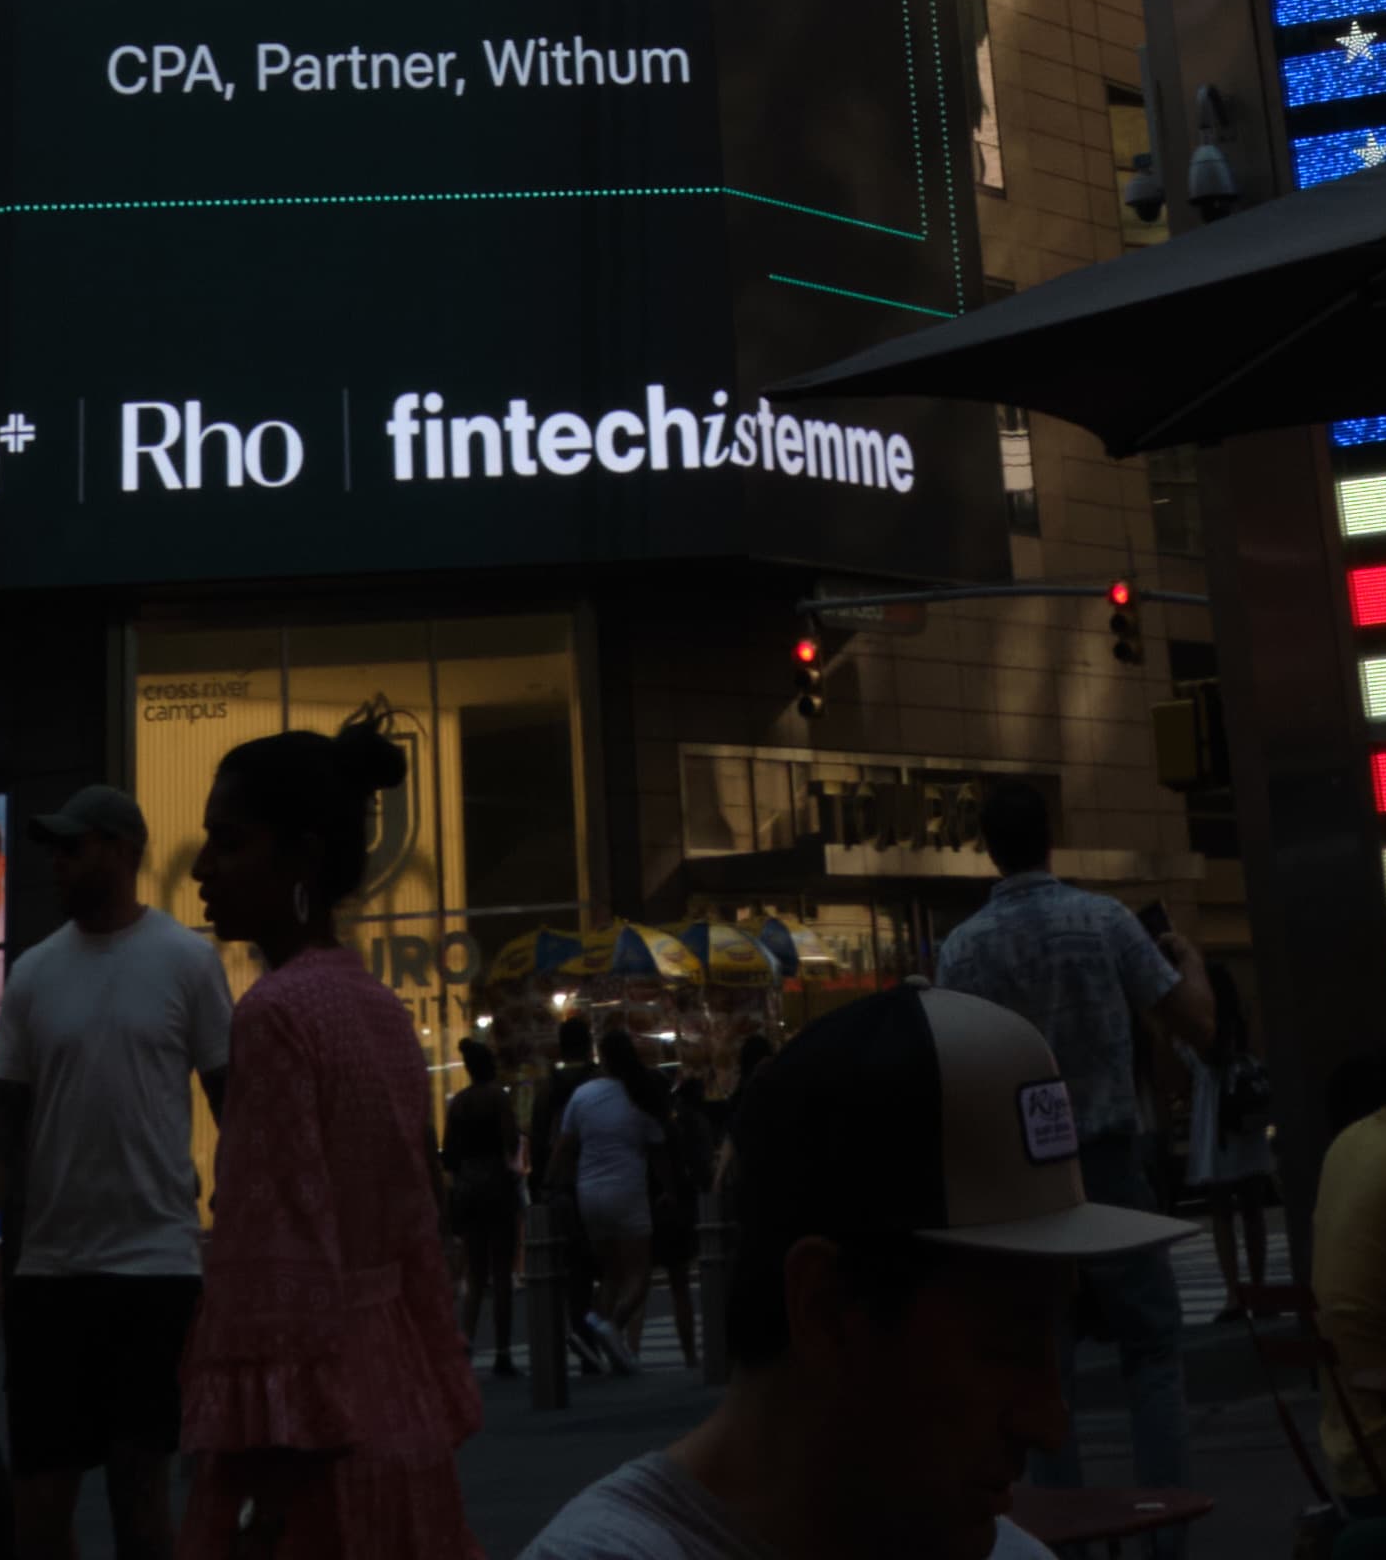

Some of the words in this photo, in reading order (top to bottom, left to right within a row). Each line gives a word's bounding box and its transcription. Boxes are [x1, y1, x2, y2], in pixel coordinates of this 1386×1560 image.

[108, 45, 234, 100] CPA,
[258, 43, 465, 95] Partner,
[483, 36, 689, 85] Withum
[123, 400, 303, 490] Rho
[143, 702, 228, 724] campus
